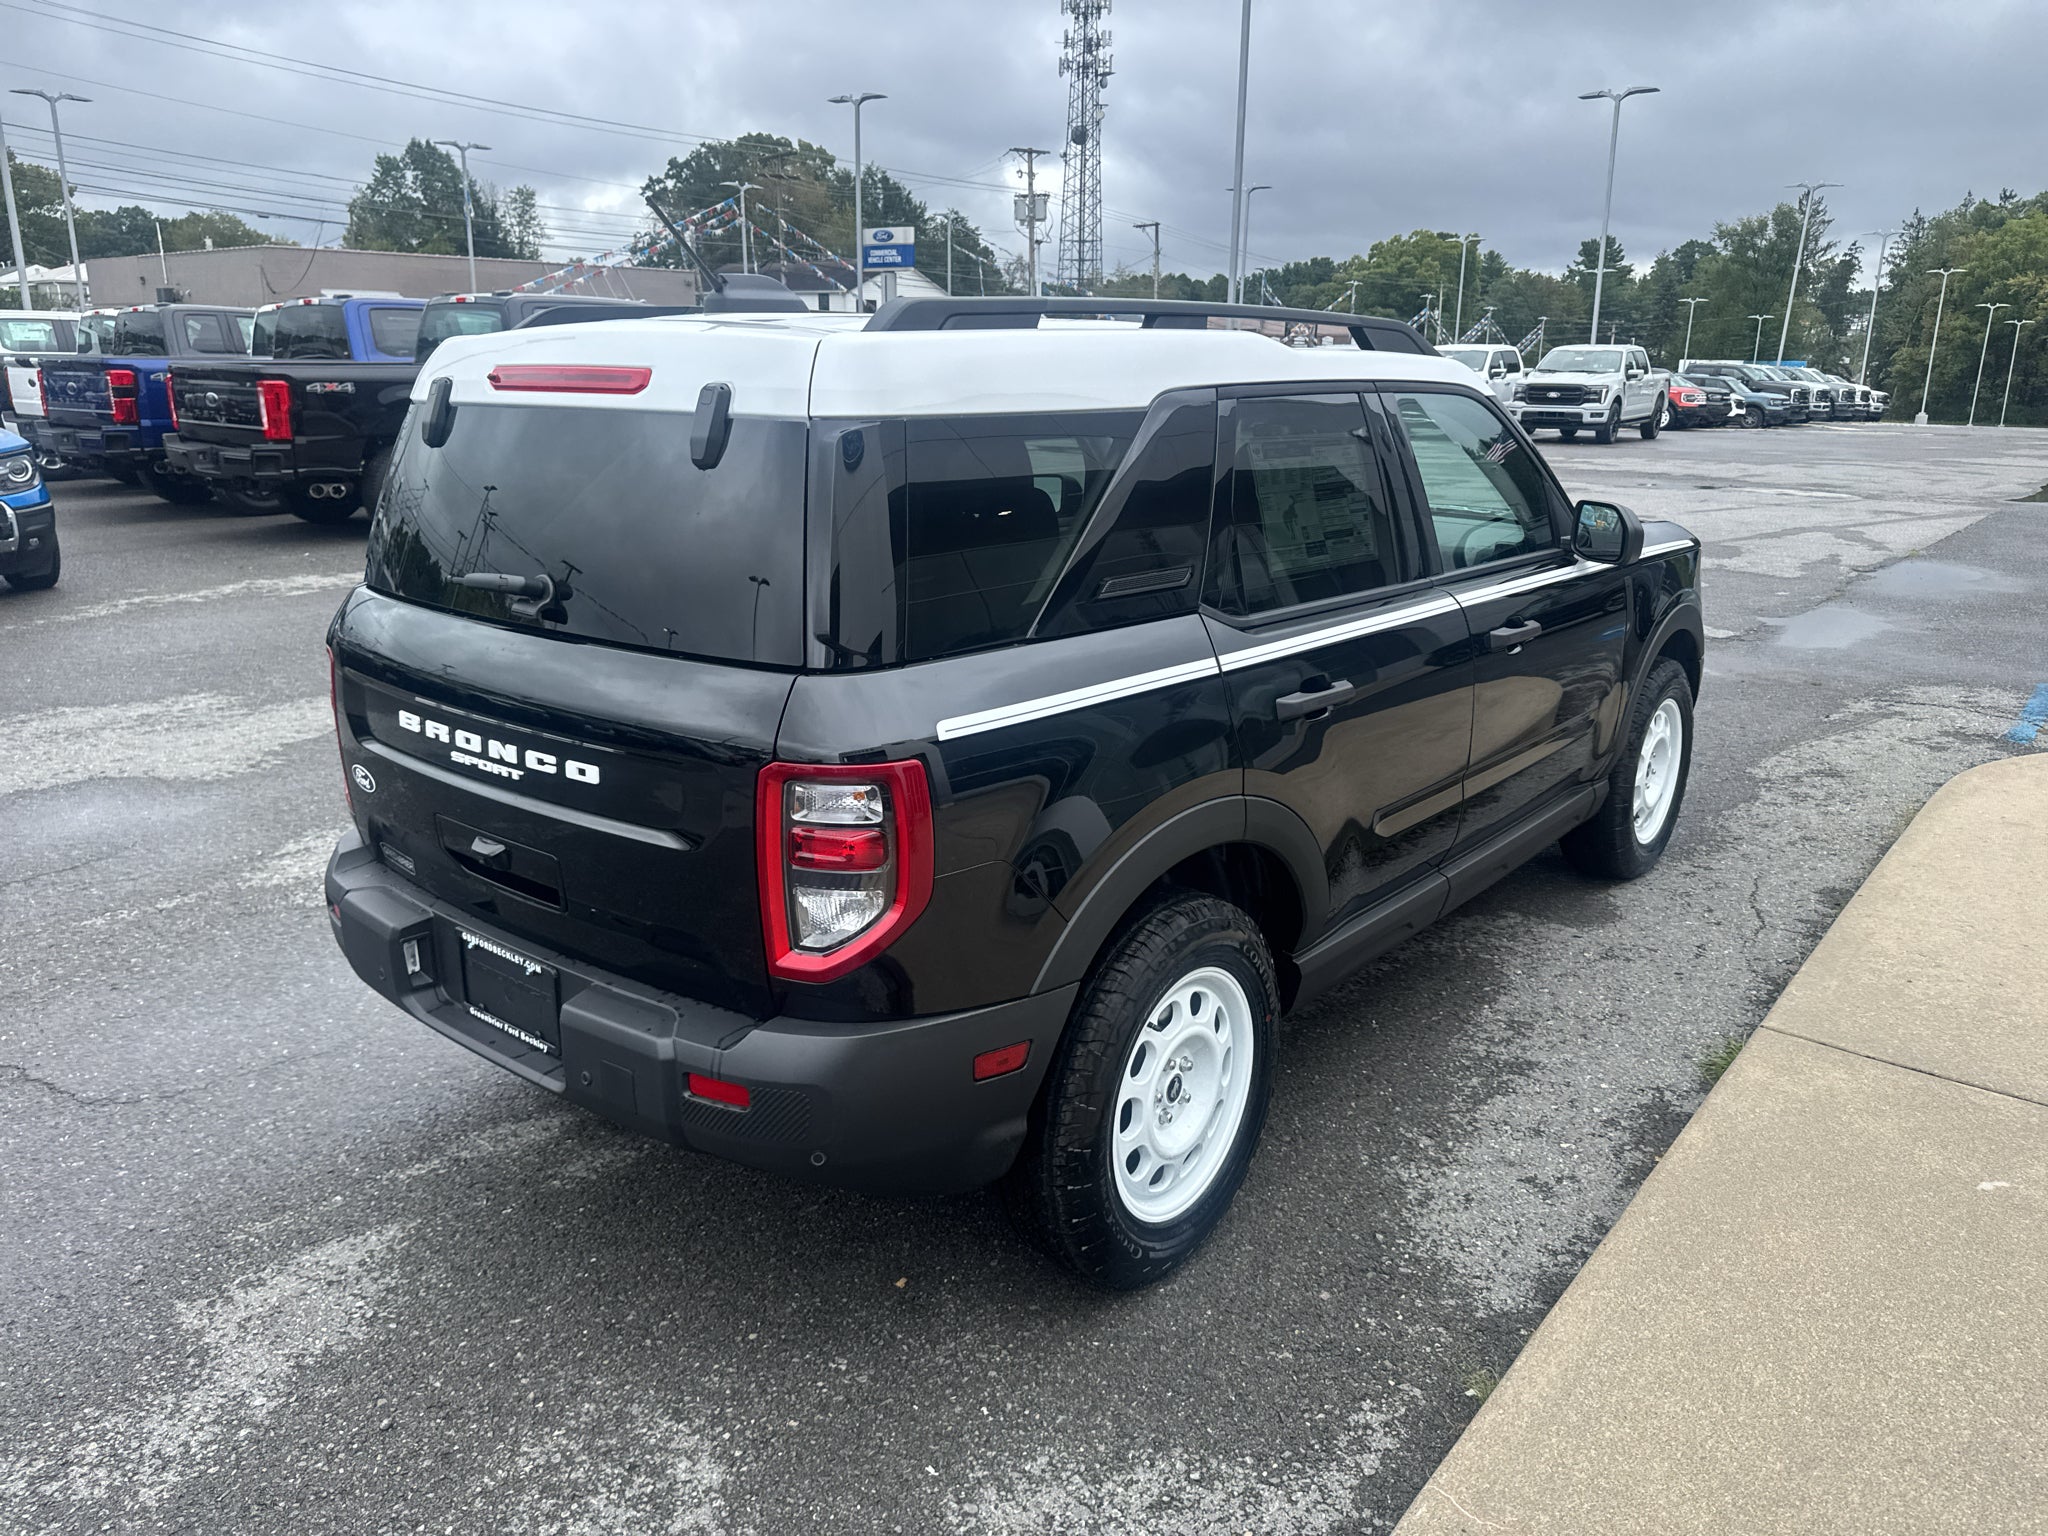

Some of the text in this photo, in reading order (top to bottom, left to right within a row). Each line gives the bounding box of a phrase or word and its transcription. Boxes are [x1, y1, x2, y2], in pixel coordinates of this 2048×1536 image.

[884, 255, 901, 263] CENTER
[399, 710, 600, 785] BRONCO
[354, 766, 373, 790] Ford
[450, 751, 524, 780] SPORT
[469, 1006, 548, 1053] Greenbrier Ford Beckley
